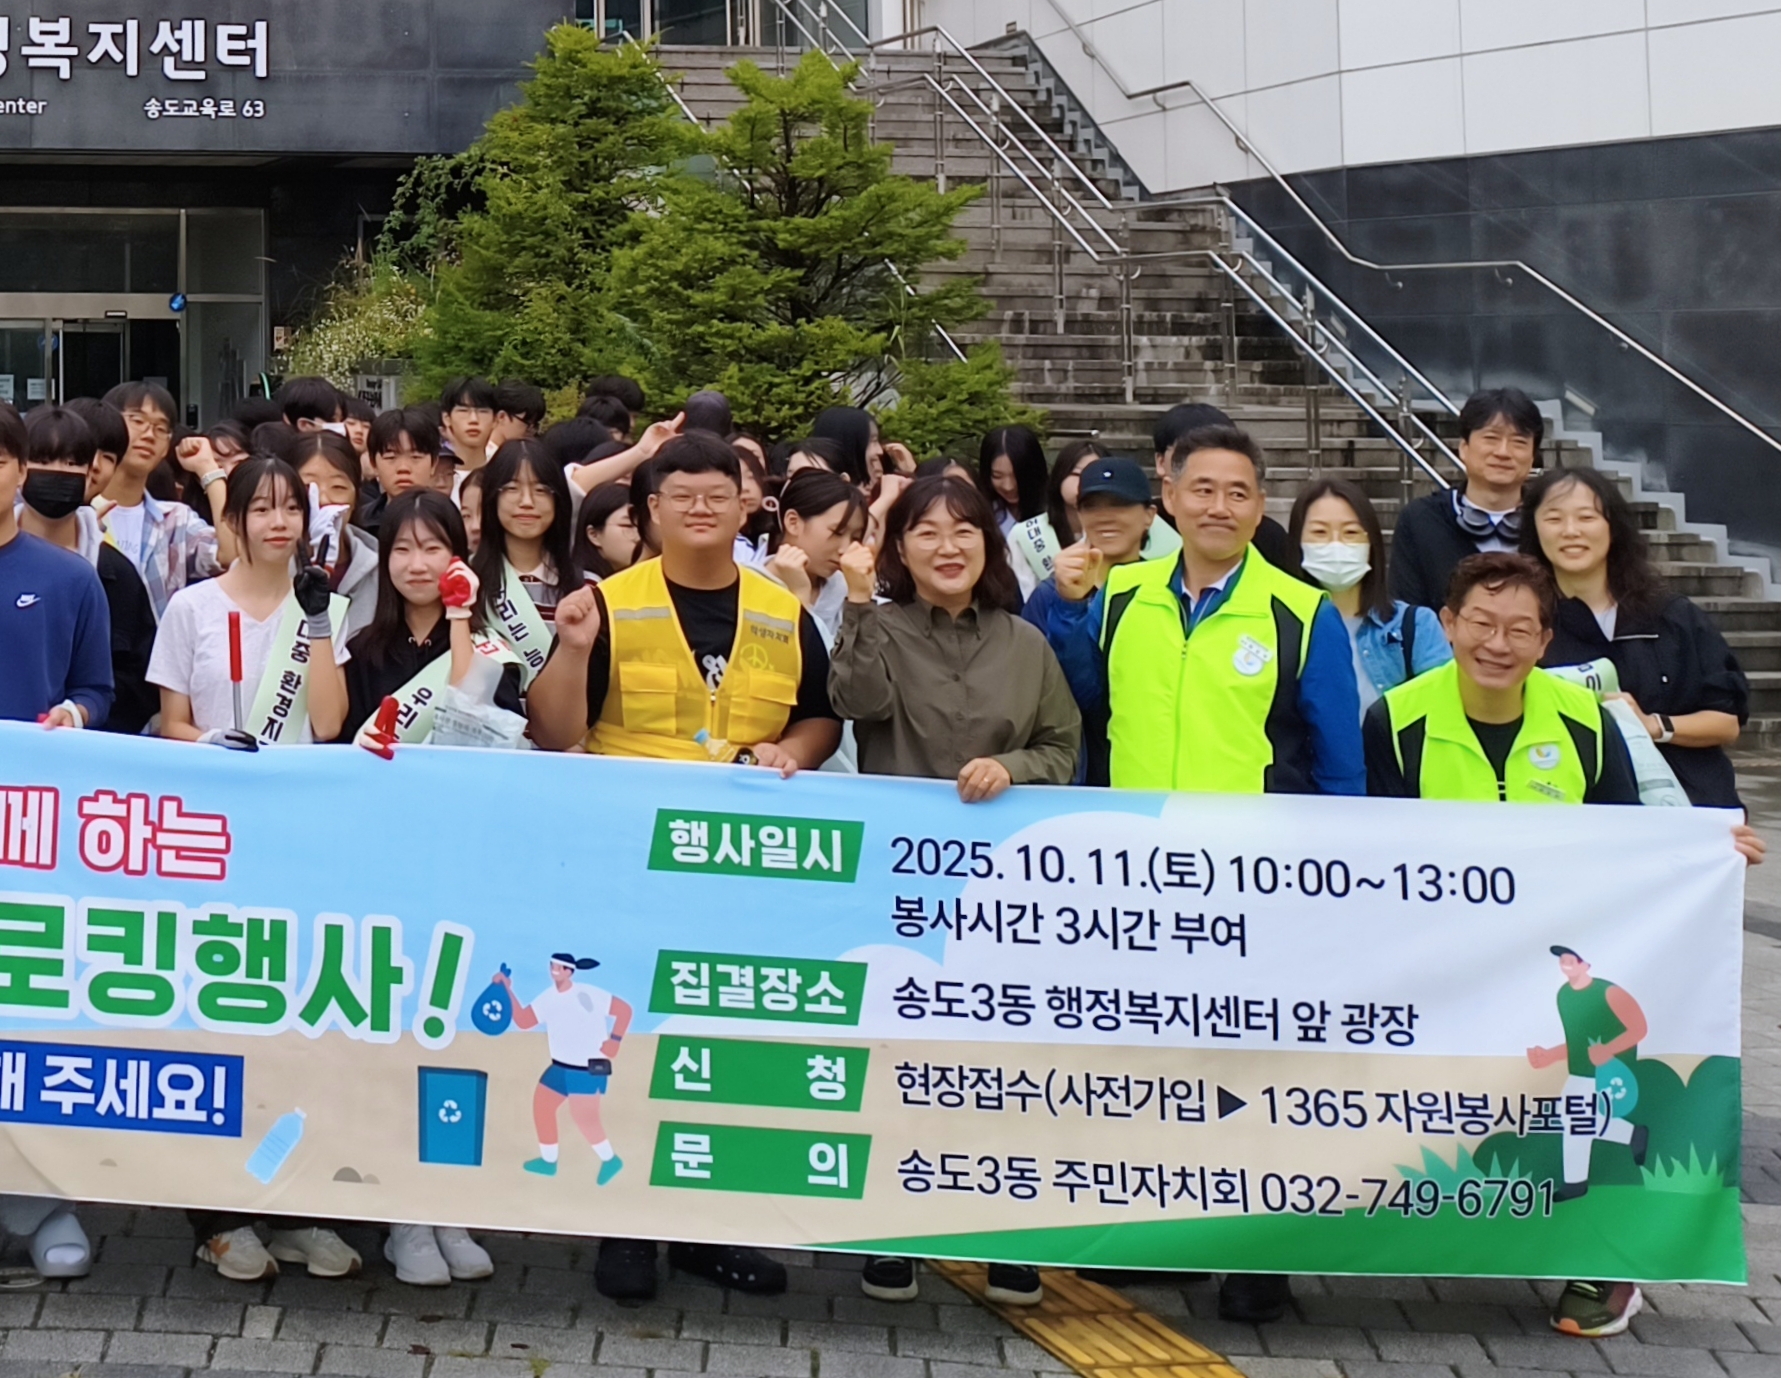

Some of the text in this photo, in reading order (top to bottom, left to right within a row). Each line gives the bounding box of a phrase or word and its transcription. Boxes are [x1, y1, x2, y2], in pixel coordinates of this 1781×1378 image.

[143, 97, 265, 120] 송도교육로 63
[259, 670, 303, 745] 환경지
[393, 686, 433, 740] 우리
[78, 791, 231, 880] 하는
[667, 816, 845, 875] 행사일시
[1228, 853, 1516, 907] 10:00~13:00
[891, 896, 1248, 959] 봉사시간 3시간 부여
[669, 960, 848, 1017] 집결장소
[892, 976, 1420, 1050] 송도3동 행정복지센터 앞 광장
[39, 1059, 226, 1126] 주세요!
[894, 1061, 1613, 1140] 현장접수(사전가입 1365 자원봉사포털)
[896, 1148, 1557, 1221] 송도3동 주민자치회 032-749-6791
